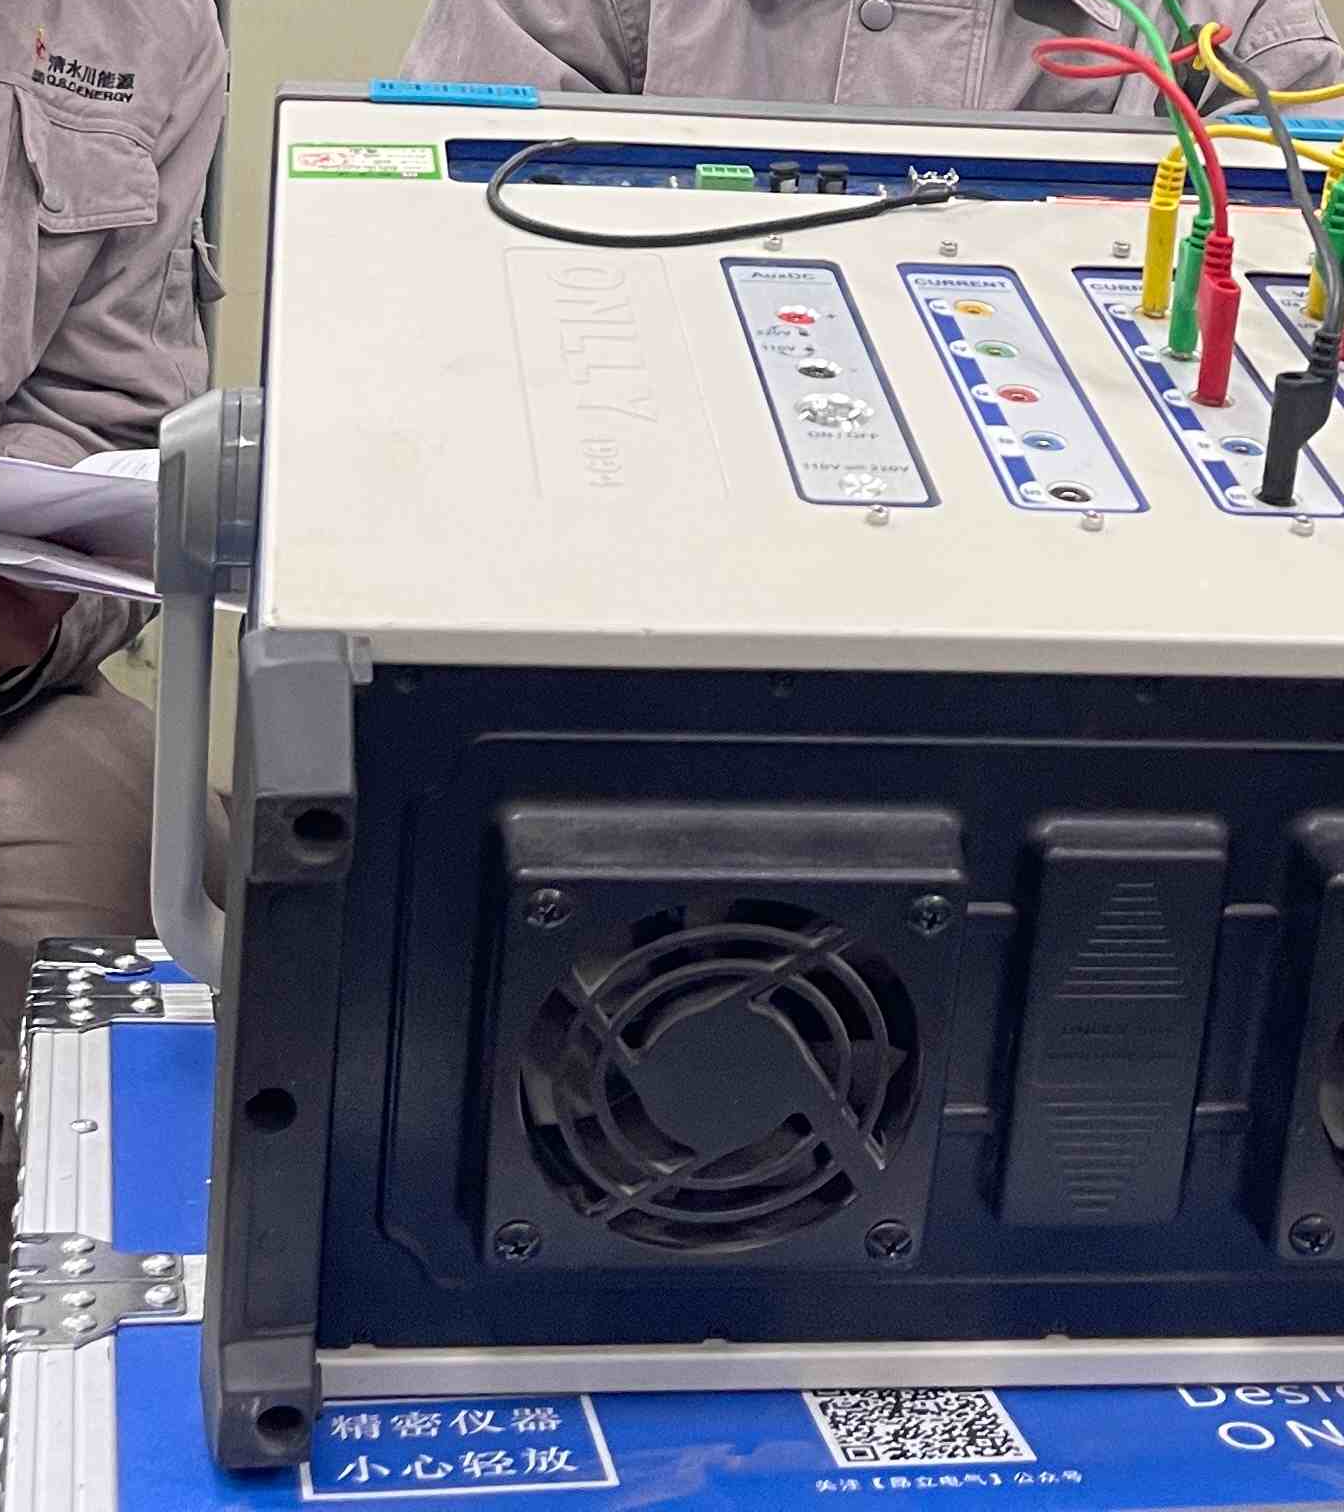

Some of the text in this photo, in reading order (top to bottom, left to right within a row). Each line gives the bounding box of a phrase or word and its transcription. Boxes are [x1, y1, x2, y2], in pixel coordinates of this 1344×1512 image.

[47, 54, 136, 90] 清水川能源
[914, 278, 1008, 289] CURRENT
[329, 1407, 564, 1441] 精密仪器
[336, 1445, 579, 1483] 小心轻放
